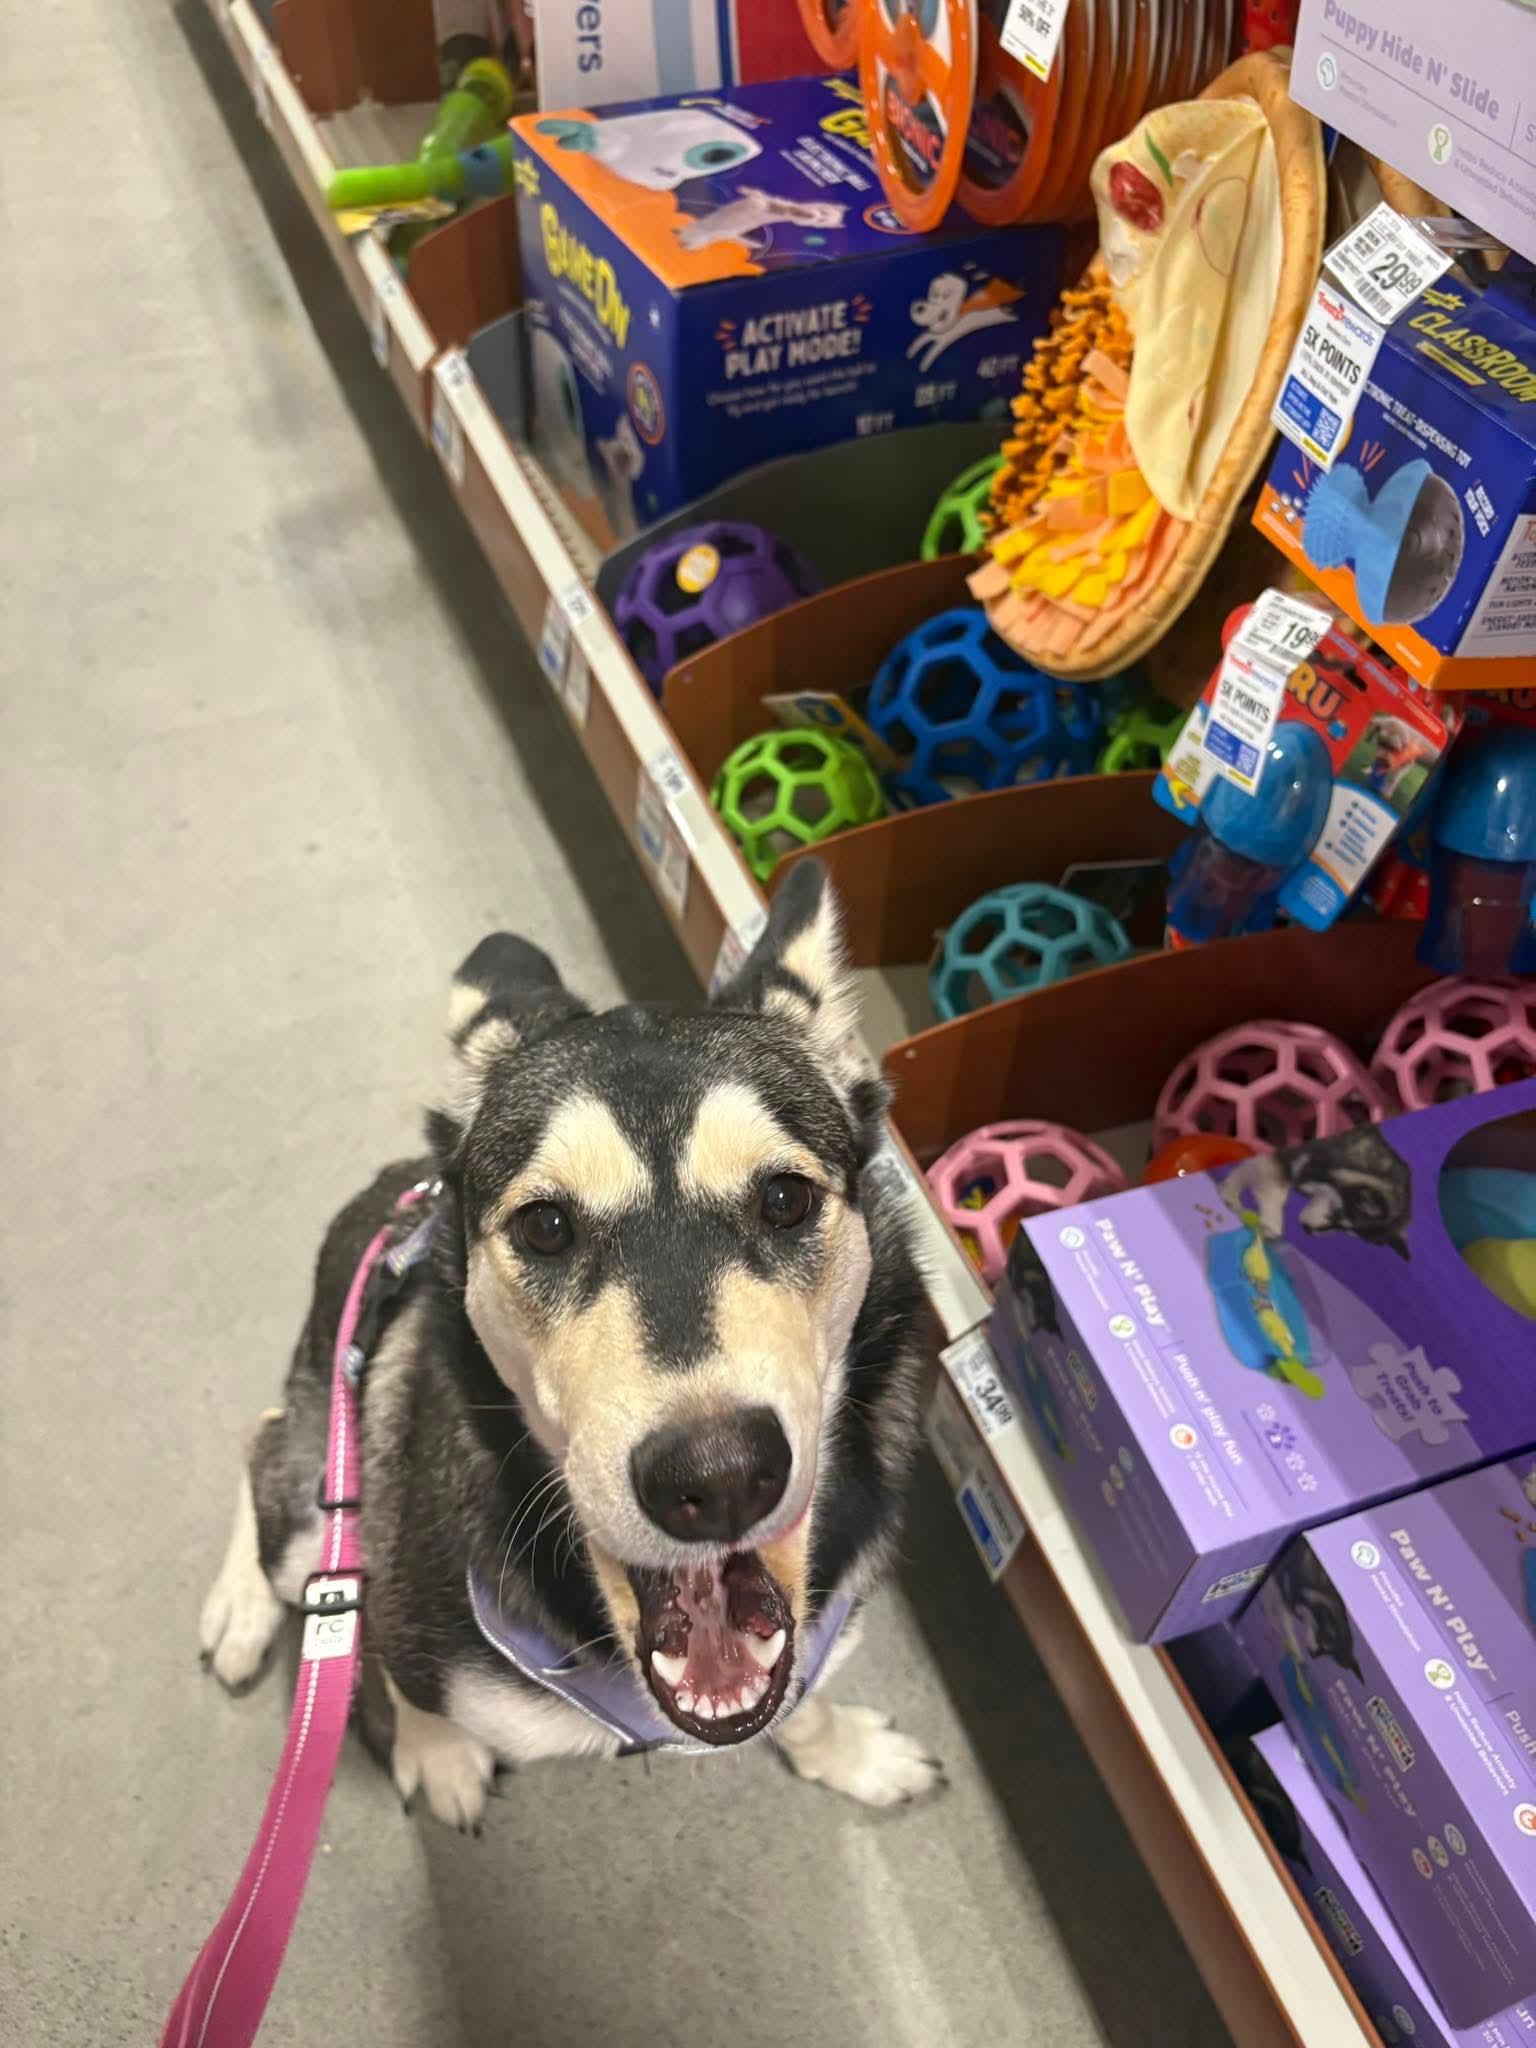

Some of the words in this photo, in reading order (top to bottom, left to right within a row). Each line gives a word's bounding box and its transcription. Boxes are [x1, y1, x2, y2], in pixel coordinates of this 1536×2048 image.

[1323, 0, 1378, 51] Puppy
[1380, 30, 1425, 75] Hide
[1426, 57, 1448, 86] N'
[1450, 72, 1500, 121] Slide
[740, 300, 850, 347] ACTIVATE
[724, 345, 783, 381] PLAY
[786, 326, 863, 369] MODE!
[1304, 325, 1320, 352] 5X
[1318, 338, 1361, 384] POINTS
[1233, 688, 1271, 723] POINTS
[1289, 661, 1343, 720] RU
[1095, 1218, 1128, 1259] Paw
[1120, 1260, 1143, 1281] N'
[1133, 1281, 1166, 1327] Play
[1174, 1353, 1200, 1390] Push
[1201, 1405, 1229, 1439] play
[1223, 1438, 1244, 1465] fun
[1427, 1398, 1443, 1416] to
[1389, 1529, 1432, 1581] Paw
[1425, 1585, 1455, 1610] N'
[1446, 1616, 1490, 1670] Play
